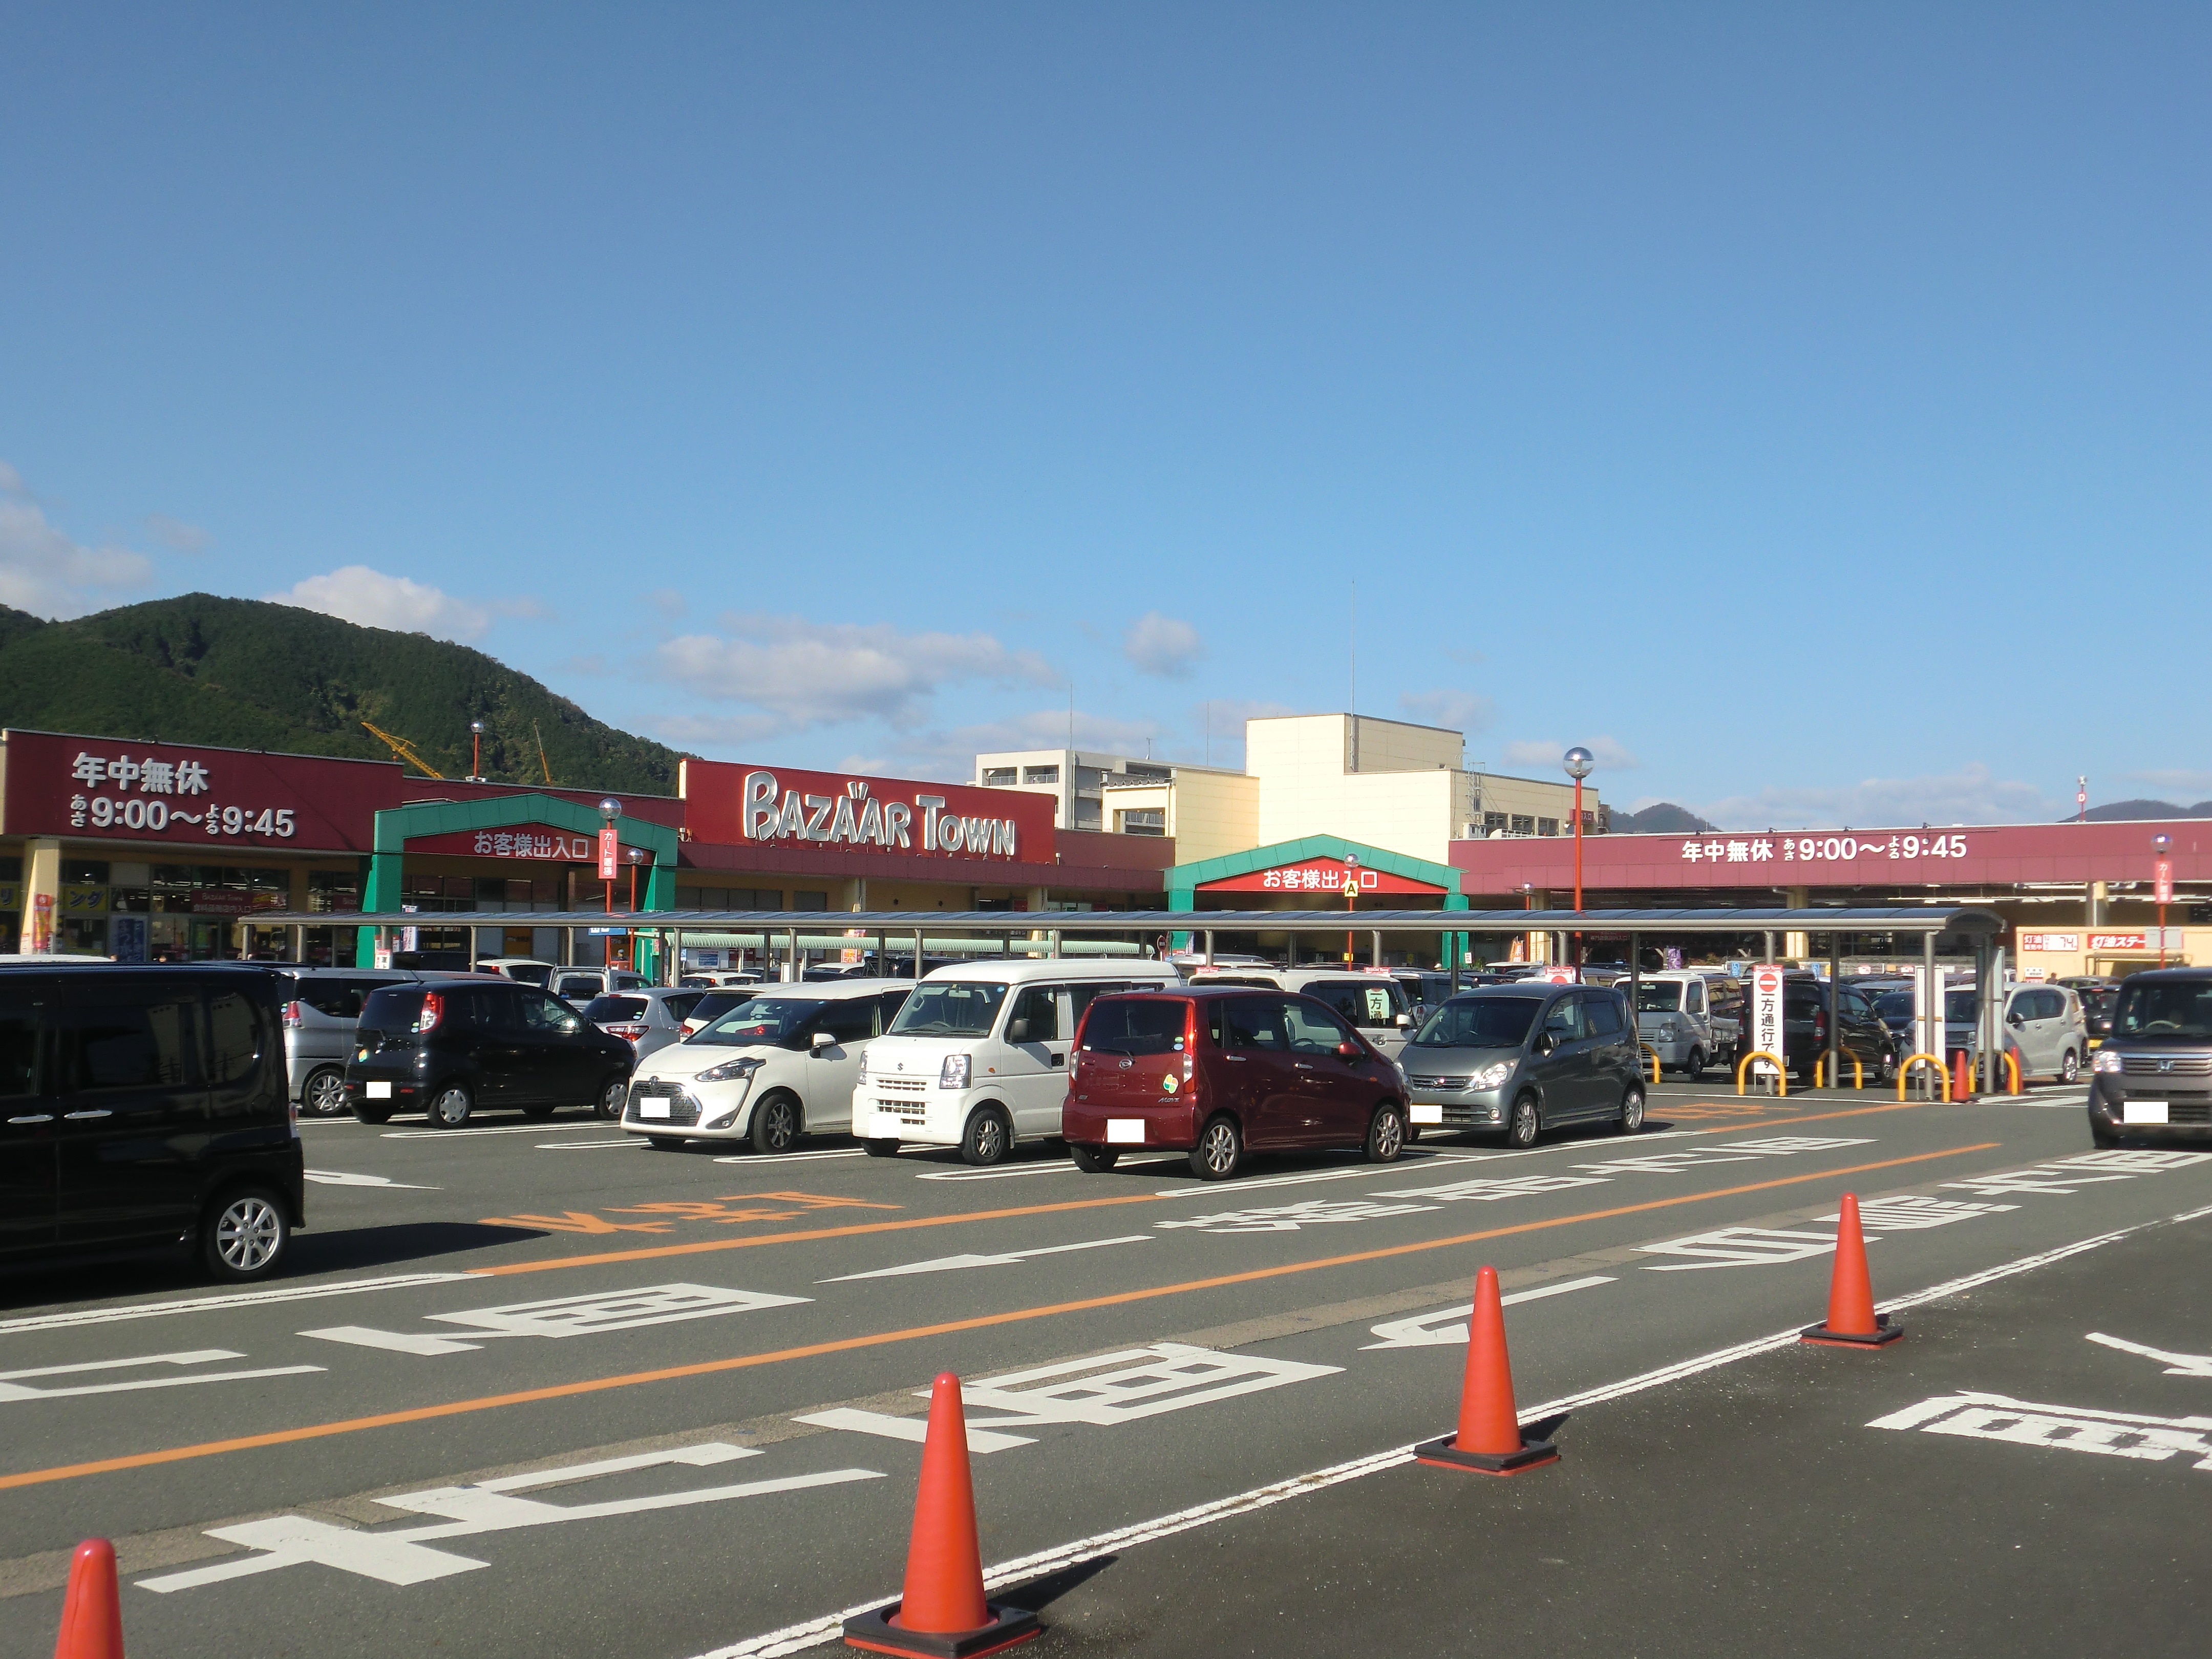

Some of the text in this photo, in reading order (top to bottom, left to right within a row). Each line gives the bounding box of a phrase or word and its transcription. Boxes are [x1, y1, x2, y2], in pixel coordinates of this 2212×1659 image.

[72, 752, 208, 795] 年中無休
[916, 794, 1015, 856] TOWN
[474, 831, 589, 859] お客様出入口
[1682, 839, 1774, 863] 年中無休
[1347, 883, 1356, 894] A
[2024, 934, 2043, 943] 灯油
